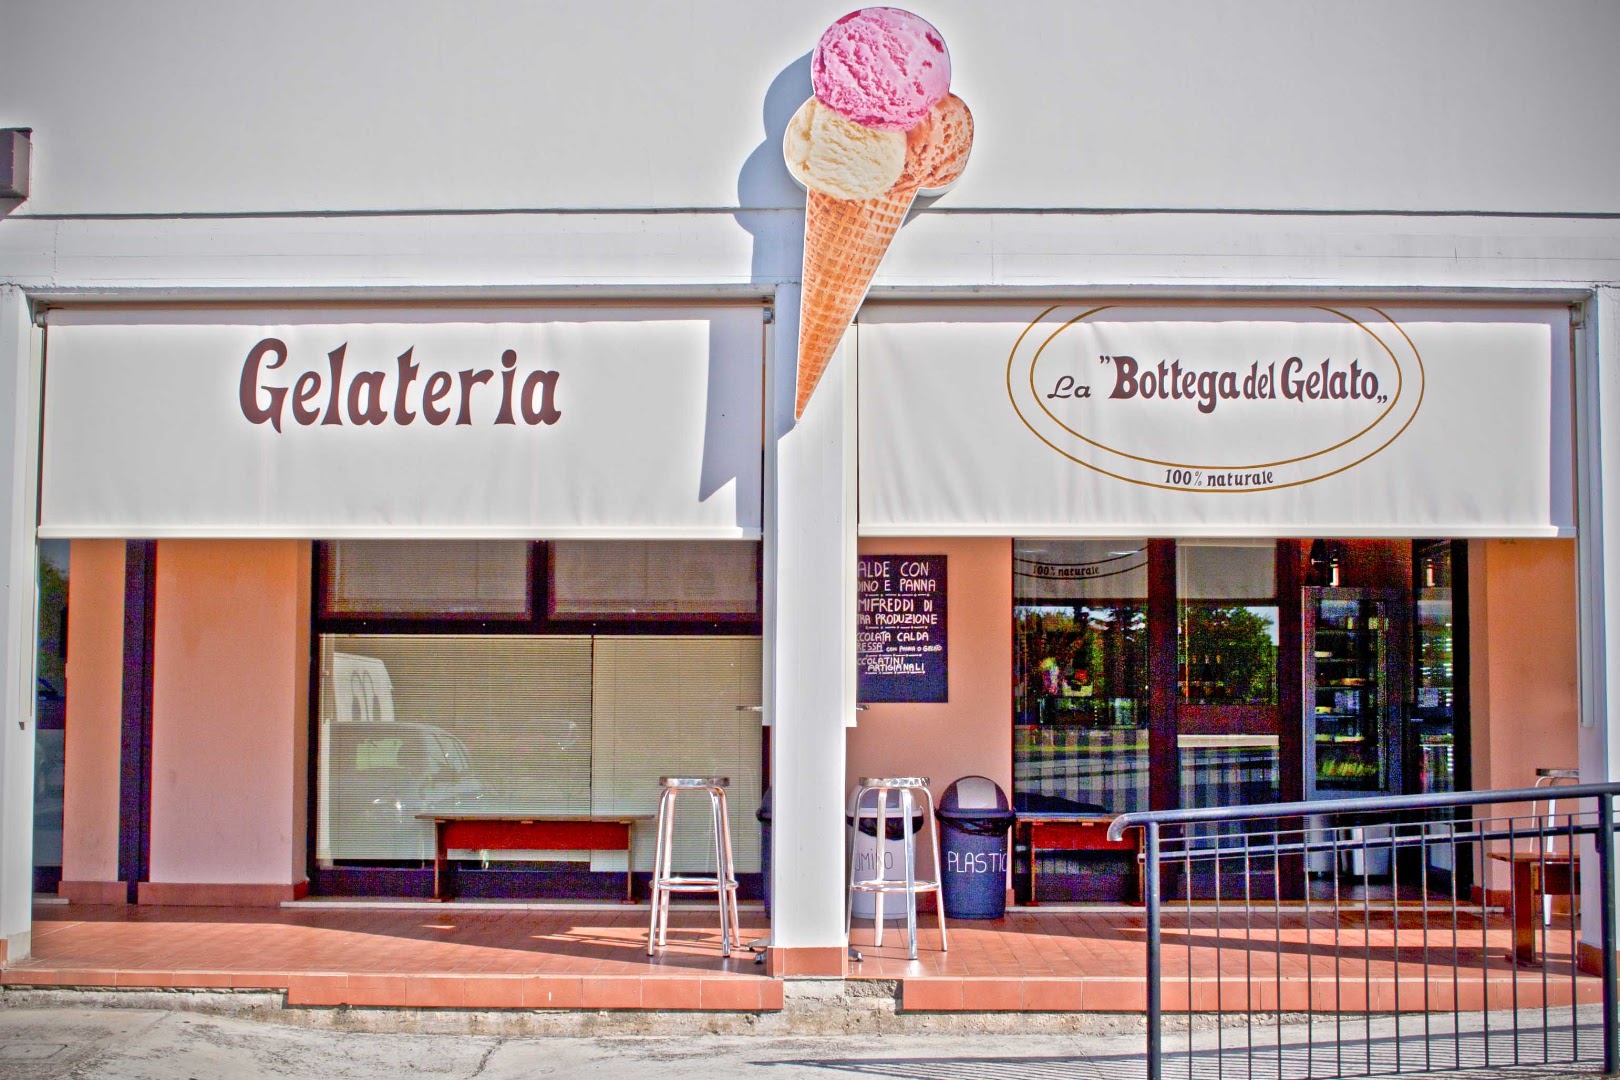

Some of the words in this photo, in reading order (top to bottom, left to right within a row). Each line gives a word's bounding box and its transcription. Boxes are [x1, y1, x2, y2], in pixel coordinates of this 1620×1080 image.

[239, 337, 562, 434] Gelateria
[1046, 375, 1092, 399] La
[1243, 360, 1277, 400] del
[1165, 469, 1202, 487] 100%
[1206, 470, 1274, 487] naturale
[900, 561, 929, 578] CON
[1058, 566, 1100, 576] naturale
[884, 579, 891, 592] E
[899, 578, 936, 592] PANNA
[923, 600, 933, 612] DI
[875, 613, 938, 625] PRODUZIONE
[896, 632, 929, 642] CALDA
[867, 663, 925, 672] ARTIGIANALI
